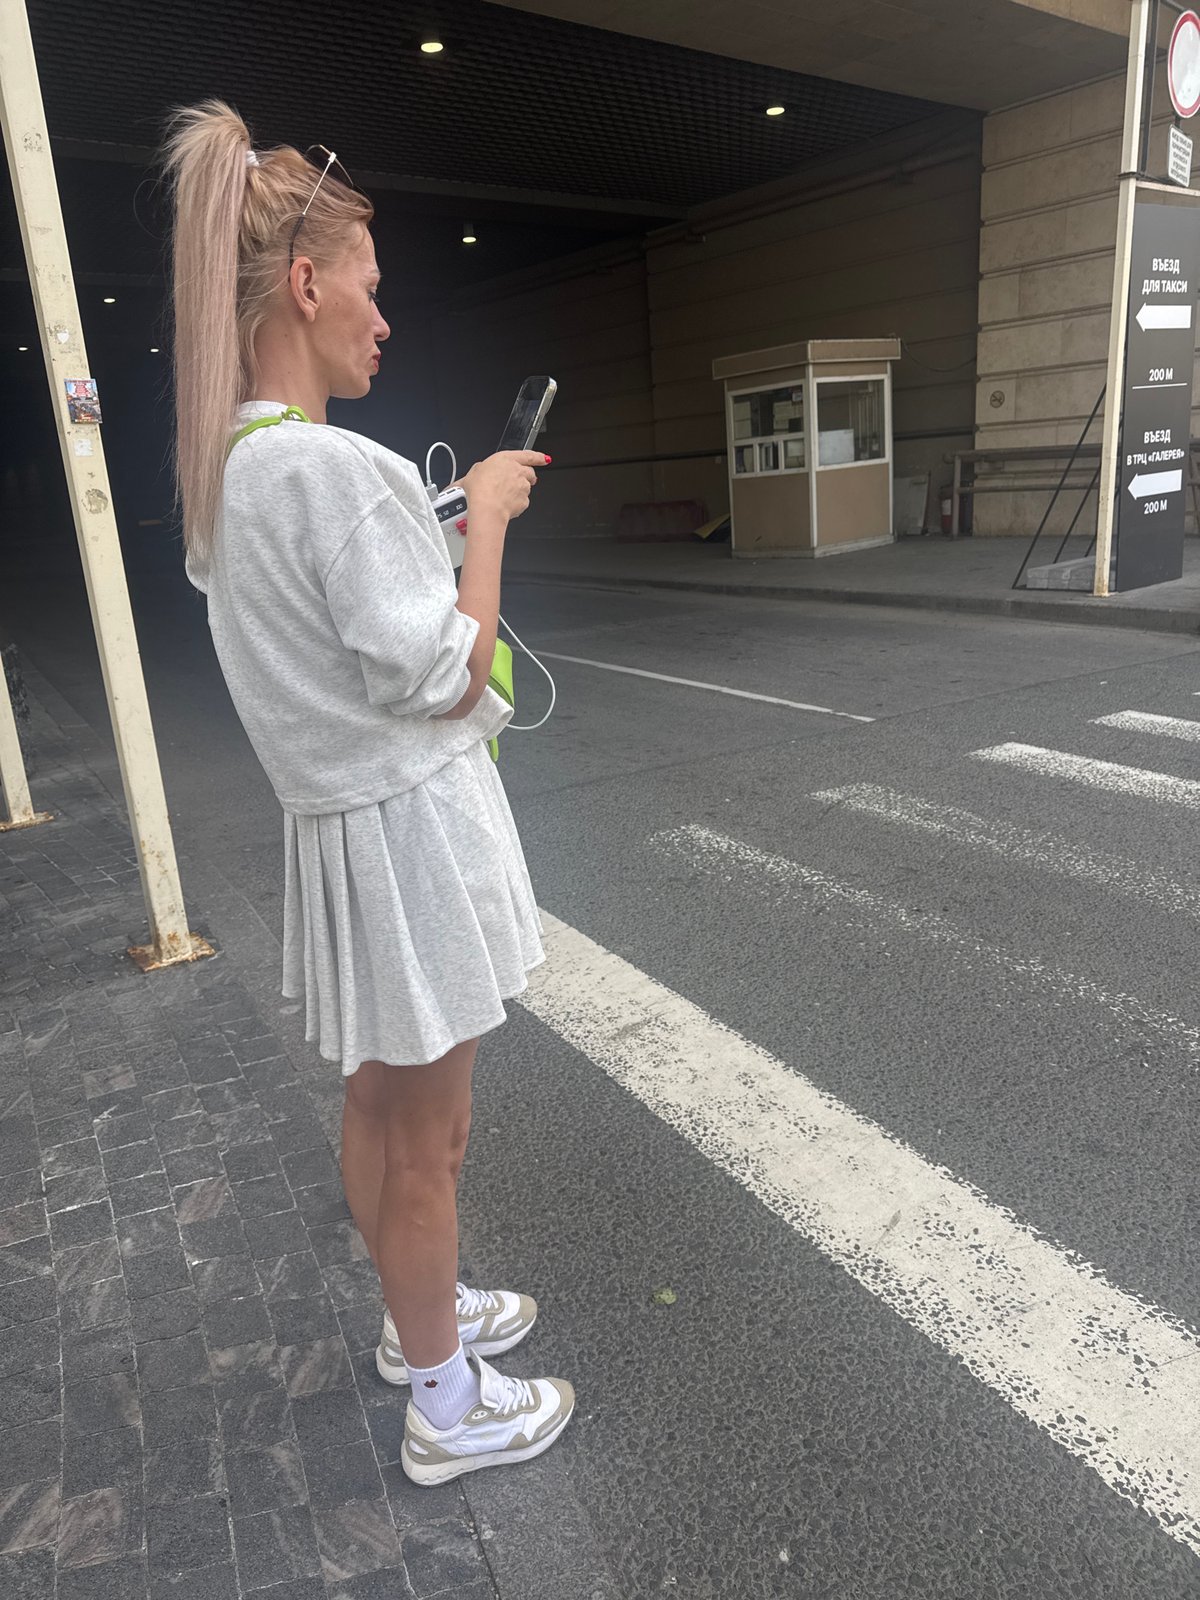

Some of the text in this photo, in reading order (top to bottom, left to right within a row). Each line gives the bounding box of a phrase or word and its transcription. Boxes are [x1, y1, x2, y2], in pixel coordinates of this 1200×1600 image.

[1152, 258, 1180, 274] ВЪЕЗД
[1142, 279, 1188, 295] ДЛЯ ТАКСИ
[1149, 367, 1173, 381] 200 М
[1144, 429, 1171, 443] ВЪЕЗД
[1126, 448, 1184, 466] В ТРЦ «ГАЛЕРЕЯ»
[1144, 499, 1167, 515] 200 М
